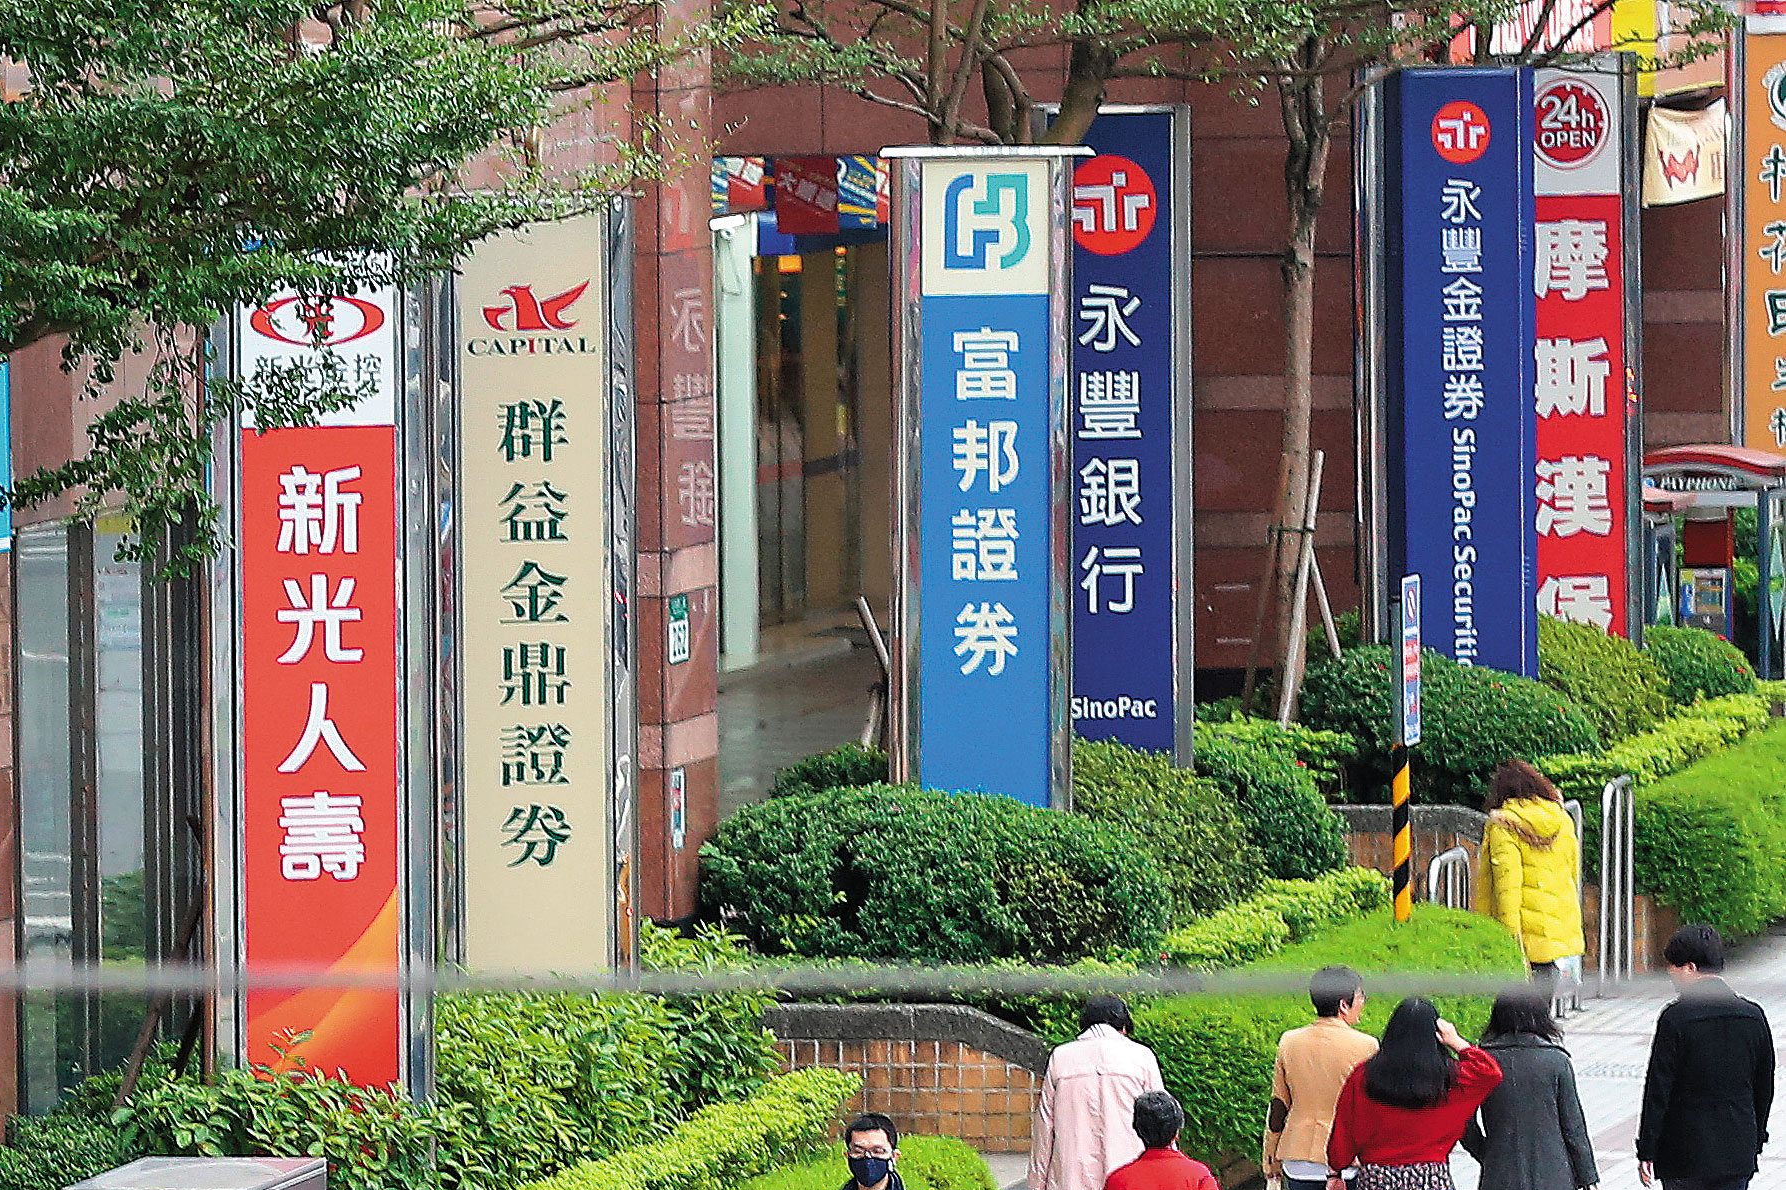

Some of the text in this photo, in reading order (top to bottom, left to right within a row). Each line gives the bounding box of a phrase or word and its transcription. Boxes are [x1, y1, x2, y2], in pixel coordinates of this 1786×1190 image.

[1540, 130, 1596, 149] OPEN
[466, 336, 597, 357] CAPITAL
[1439, 178, 1485, 420] 永豐金證券
[952, 326, 1020, 676] 富邦證券
[1078, 284, 1143, 614] 永豐銀行
[1452, 427, 1477, 541] SinoPac
[276, 464, 367, 881] 新光人壽
[498, 398, 572, 868] 群益金鼎證券
[1071, 696, 1158, 720] SinoPac
